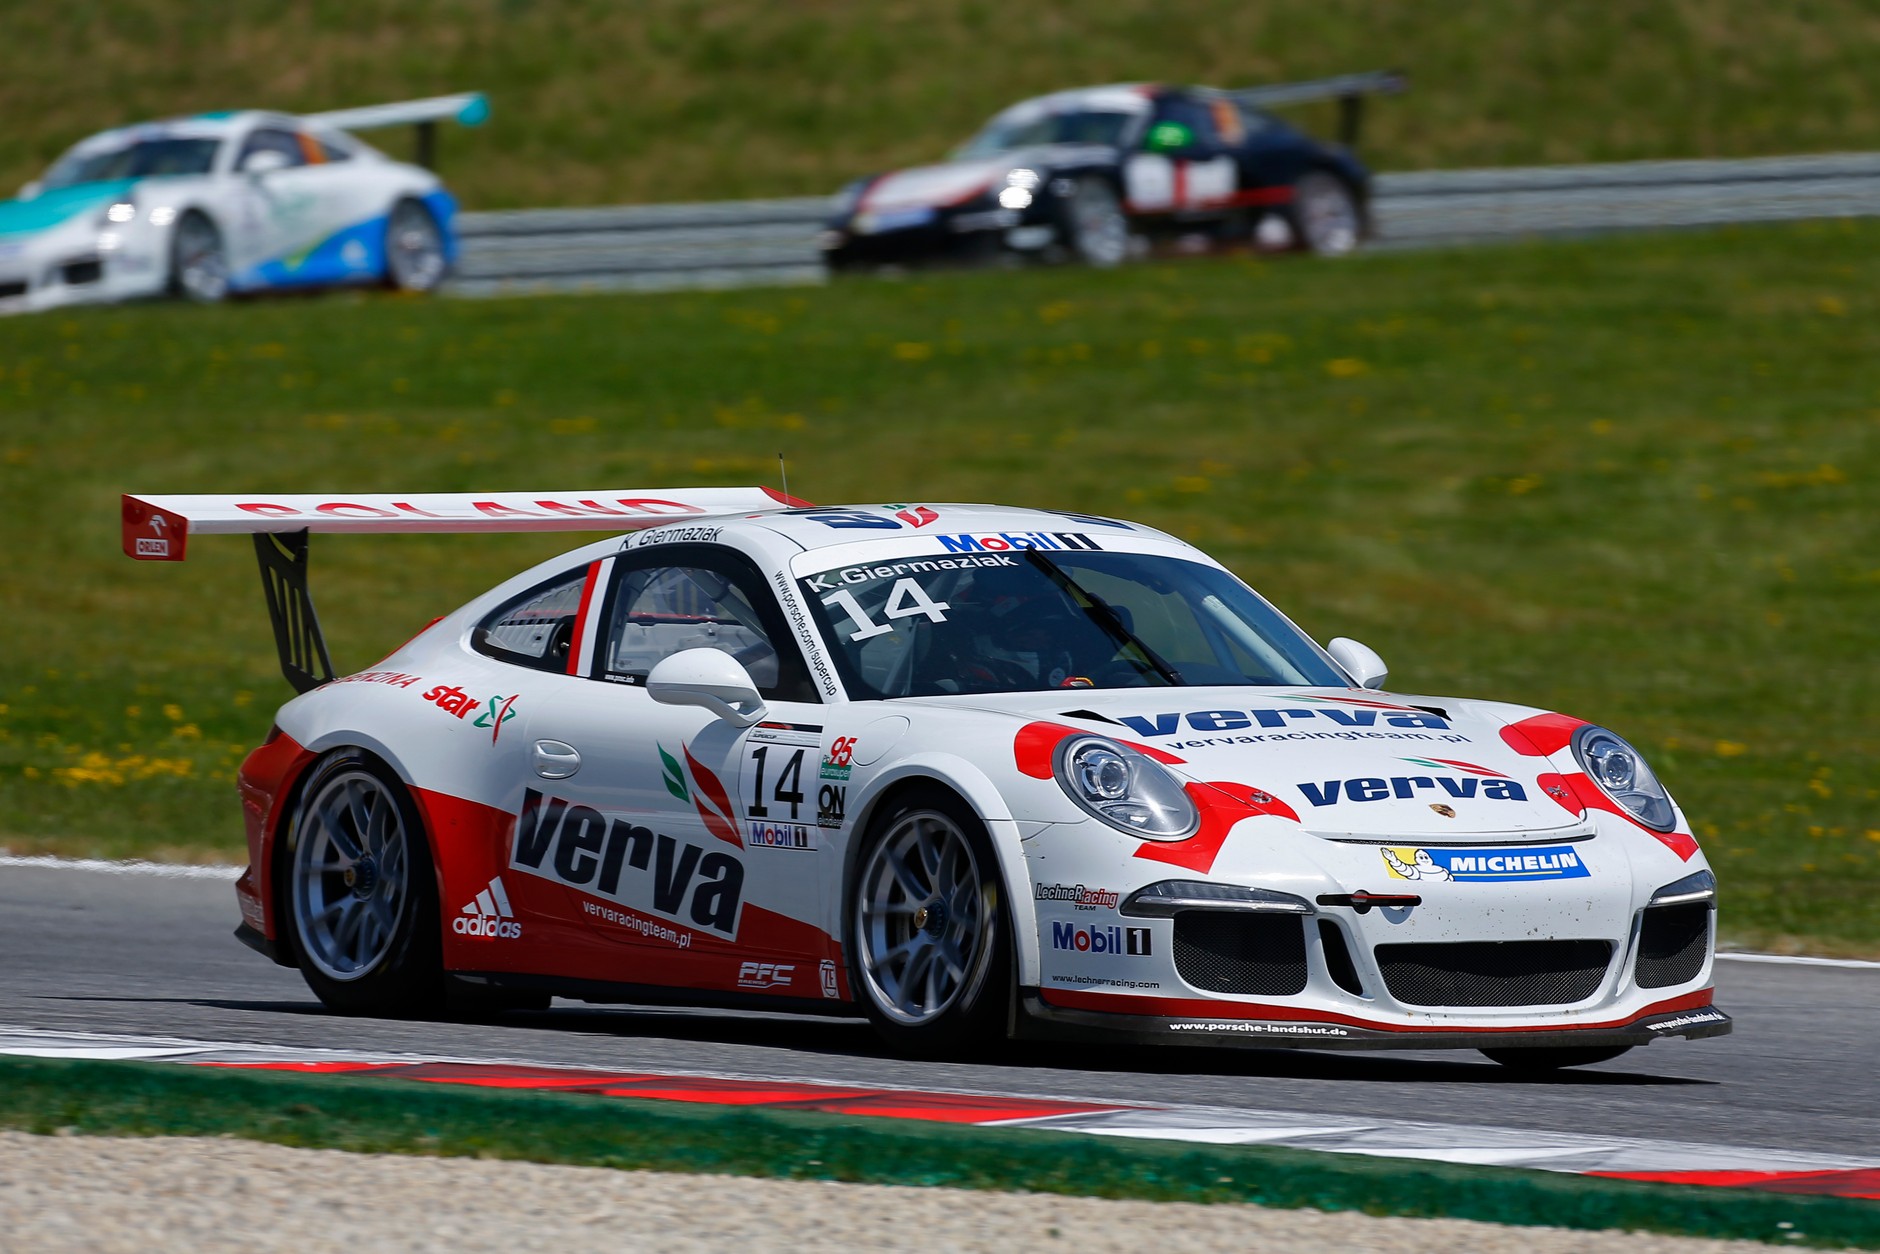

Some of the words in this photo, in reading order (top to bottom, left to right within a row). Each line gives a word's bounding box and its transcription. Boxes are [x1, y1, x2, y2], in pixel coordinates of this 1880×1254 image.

[234, 498, 706, 518] POLAND
[138, 540, 166, 554] ORLEN
[638, 525, 725, 546] Giermaziak
[936, 532, 1061, 553] Mobil
[820, 577, 951, 643] 14
[774, 569, 838, 697] www.porsche.com/supercup
[421, 685, 482, 720] star
[1116, 707, 1454, 737] verva
[831, 735, 858, 768] 95
[1164, 729, 1472, 751] vervaracingteam.pl
[748, 746, 805, 820] 14
[1296, 776, 1529, 808] verva
[752, 822, 792, 847] Mobil
[514, 786, 745, 935] verva
[1449, 852, 1579, 872] MICHELIN
[1035, 883, 1119, 909] LechneRacing
[452, 913, 522, 939] adidas
[582, 900, 692, 949] vervaracingteam.pl
[1052, 921, 1122, 955] Mobil
[738, 961, 795, 982] PFC
[1051, 974, 1160, 989] www.lechnerracing.com
[1169, 1022, 1348, 1036] www.porsche-landshut.de
